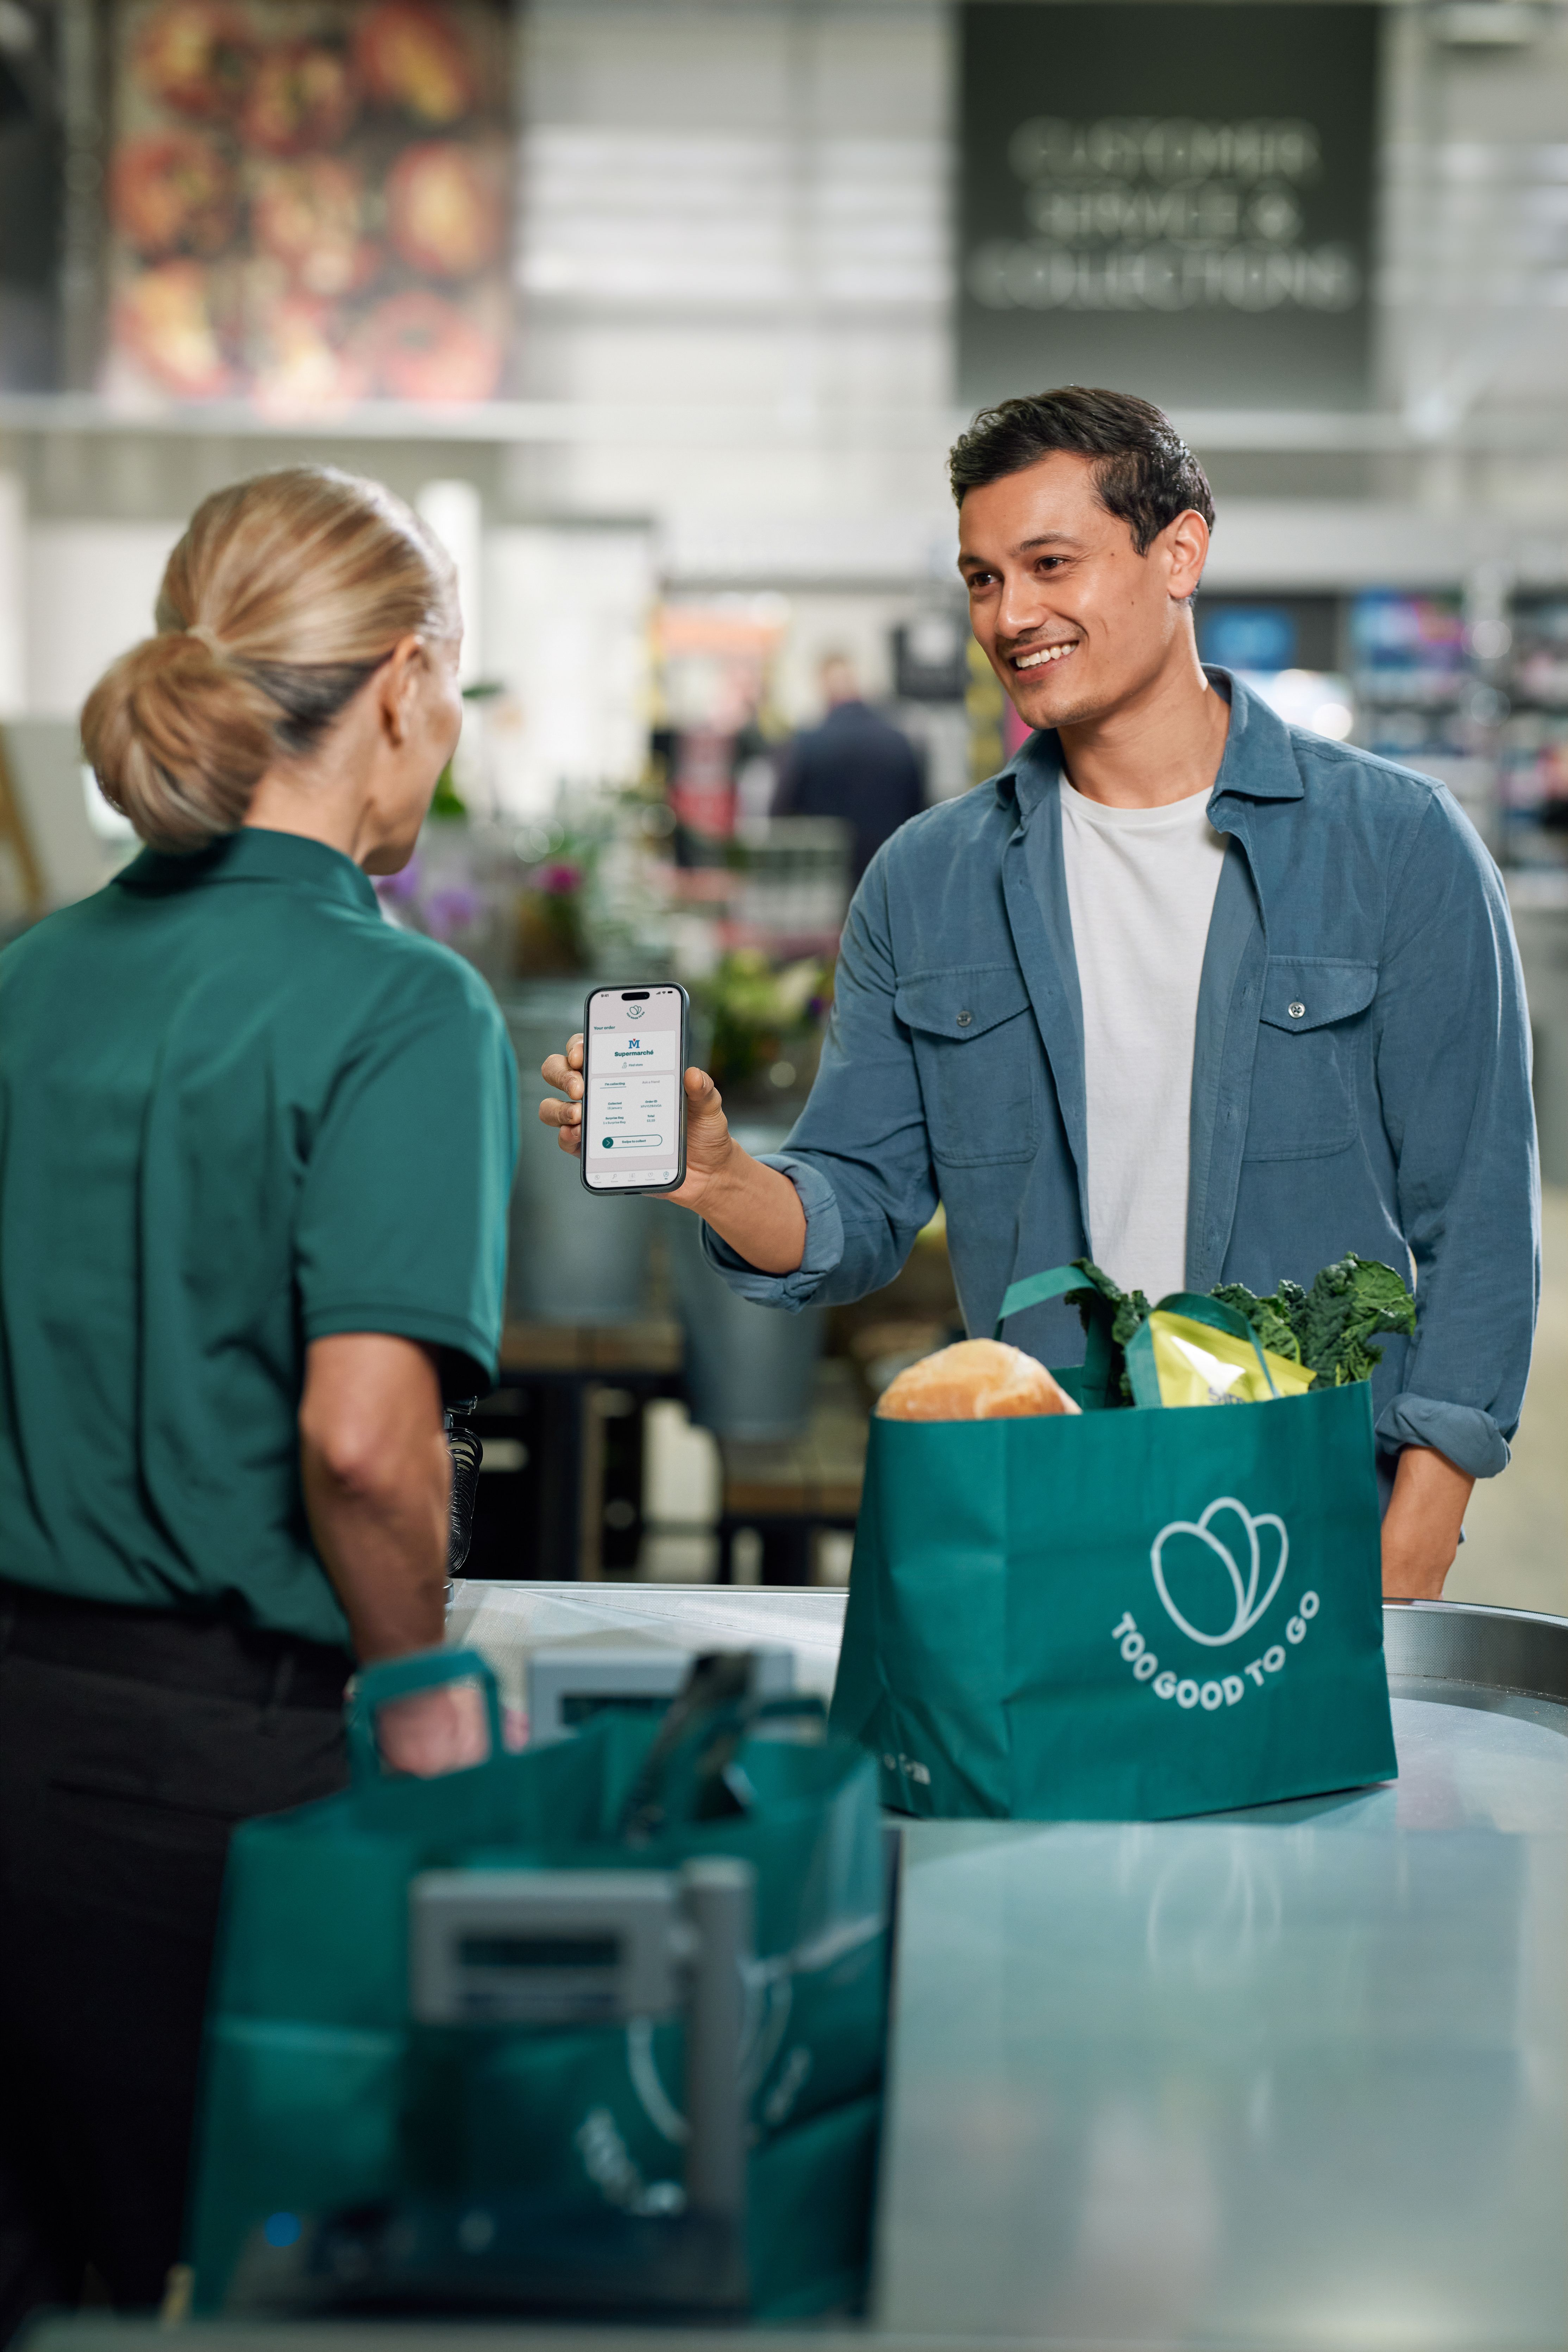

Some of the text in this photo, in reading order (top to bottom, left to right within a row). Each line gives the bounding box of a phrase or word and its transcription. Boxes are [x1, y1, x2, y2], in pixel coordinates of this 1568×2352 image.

[1111, 1590, 1320, 1711] TOO GOOD TO GO
